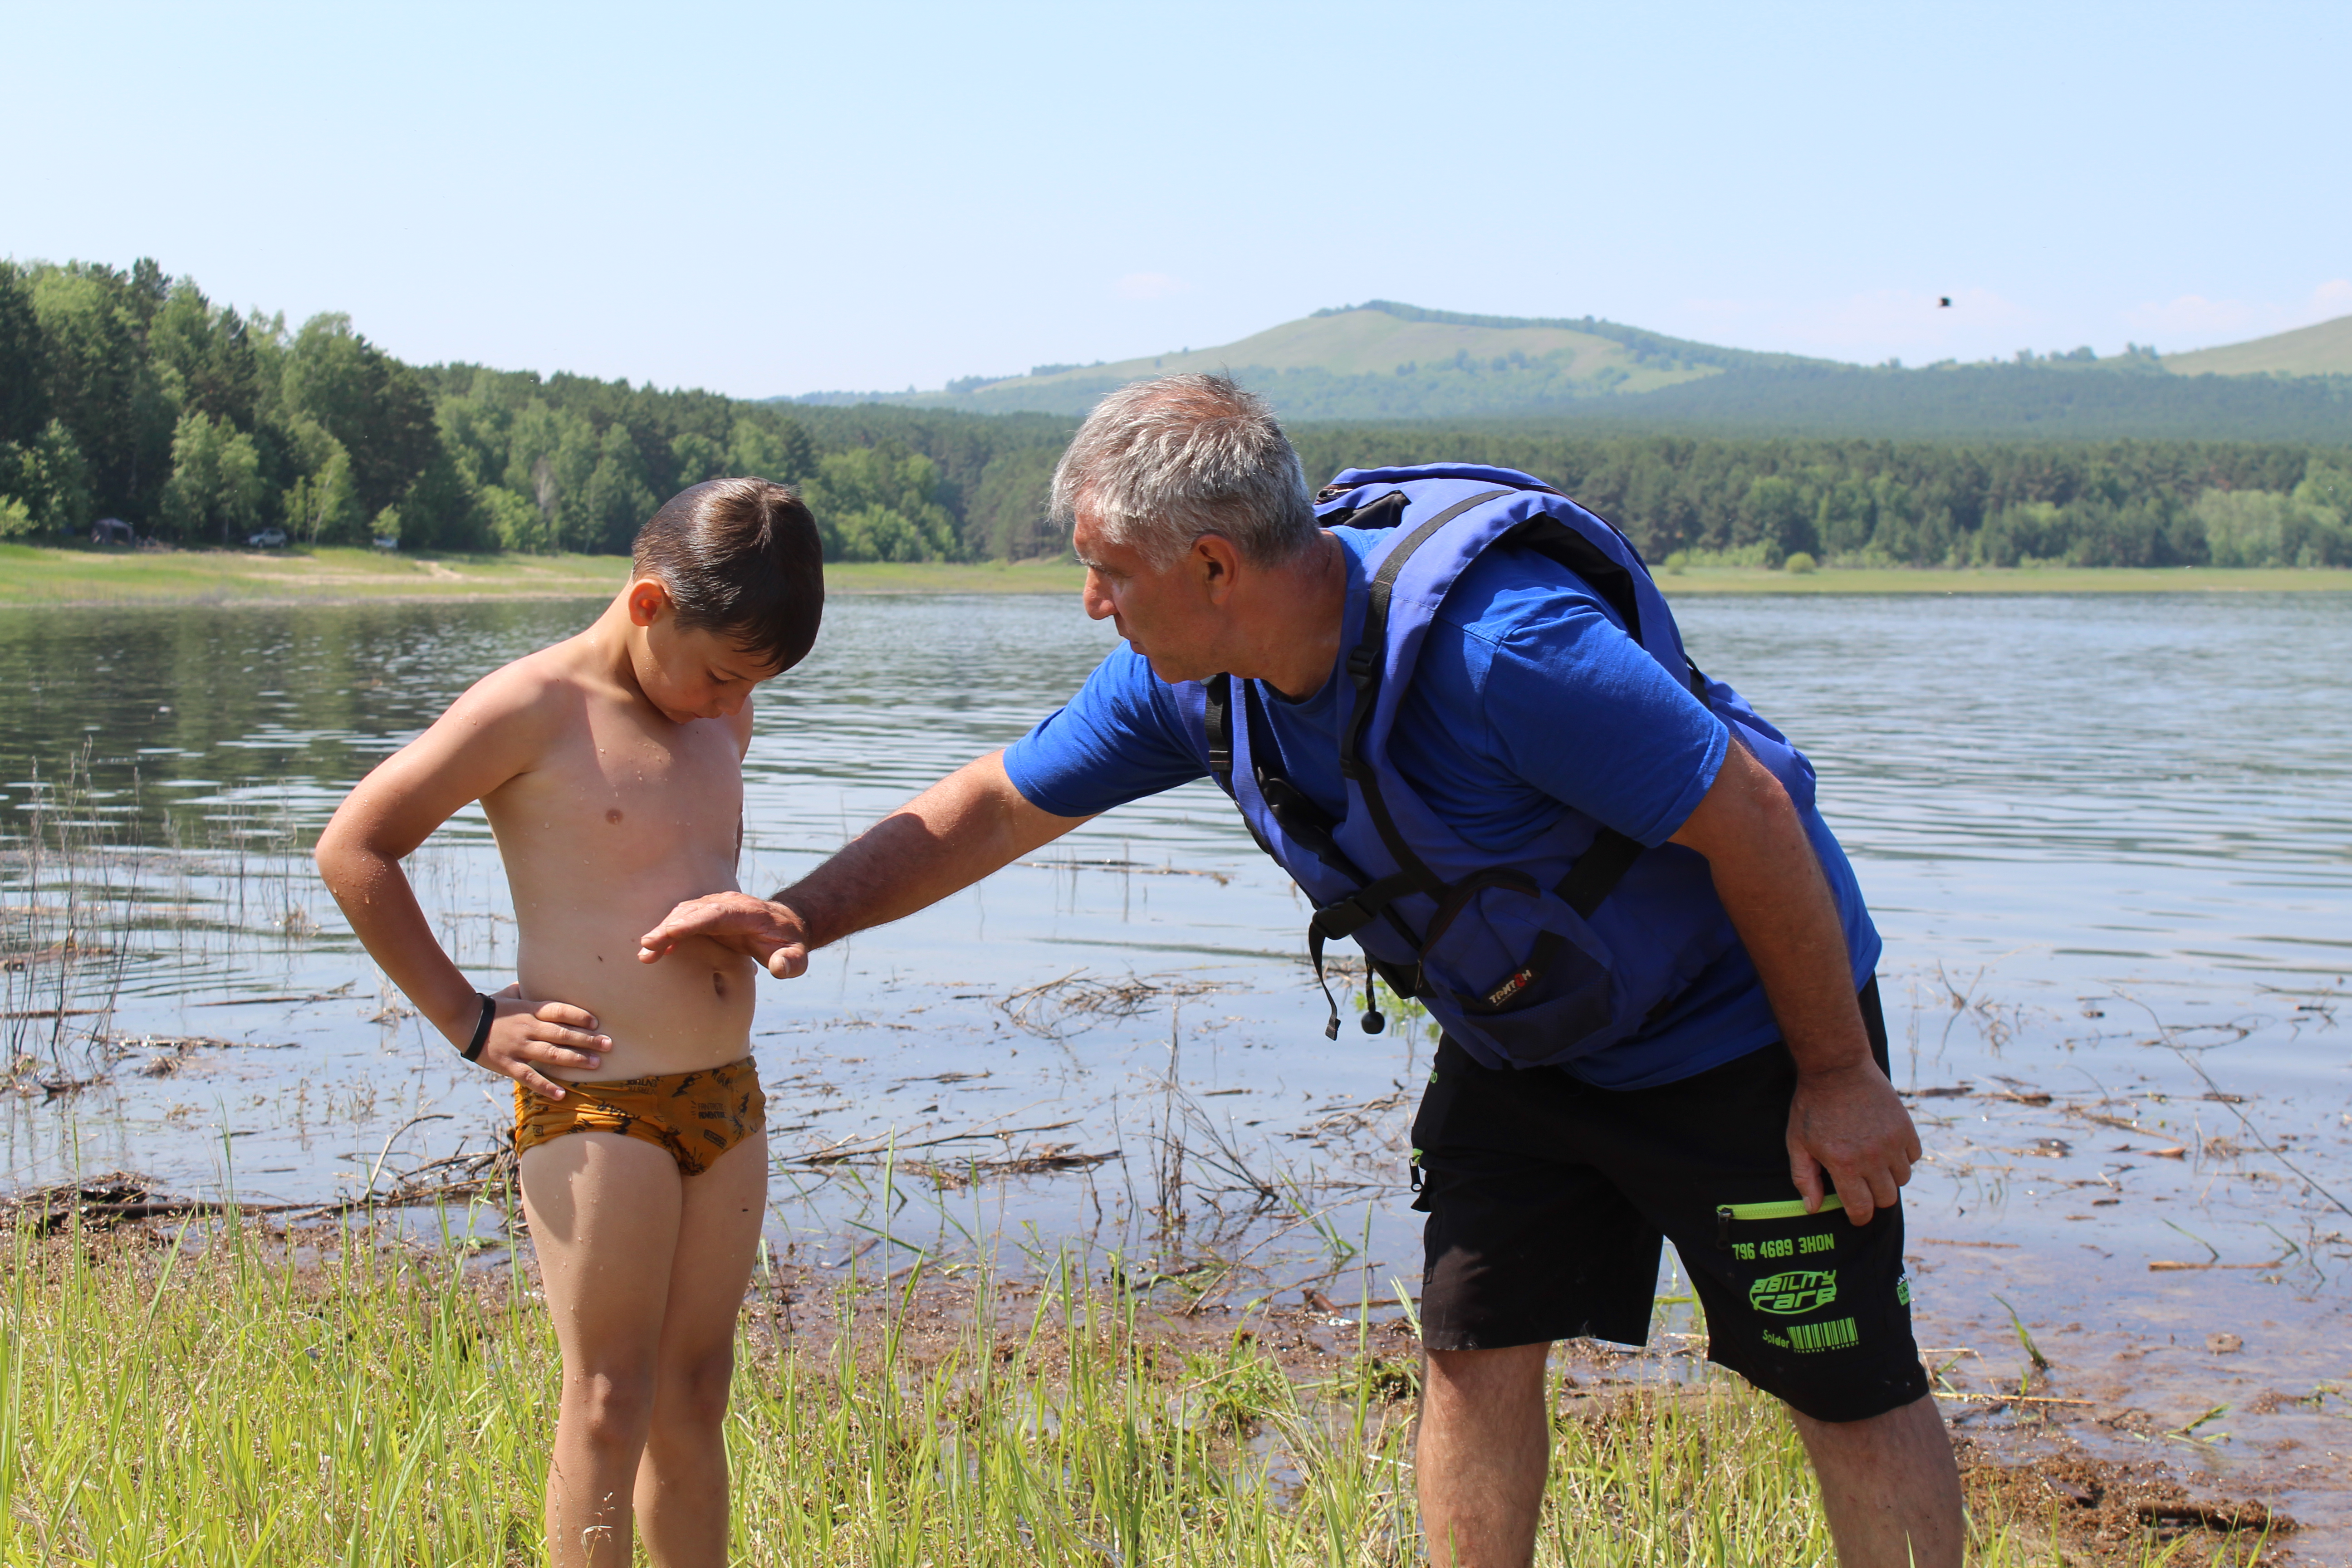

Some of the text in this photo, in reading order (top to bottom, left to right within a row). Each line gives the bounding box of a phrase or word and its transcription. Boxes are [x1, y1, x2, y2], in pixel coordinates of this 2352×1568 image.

[1732, 1243, 1755, 1259] 796
[1760, 1239, 1793, 1258] 4689
[1762, 1329, 1789, 1348] Spider
